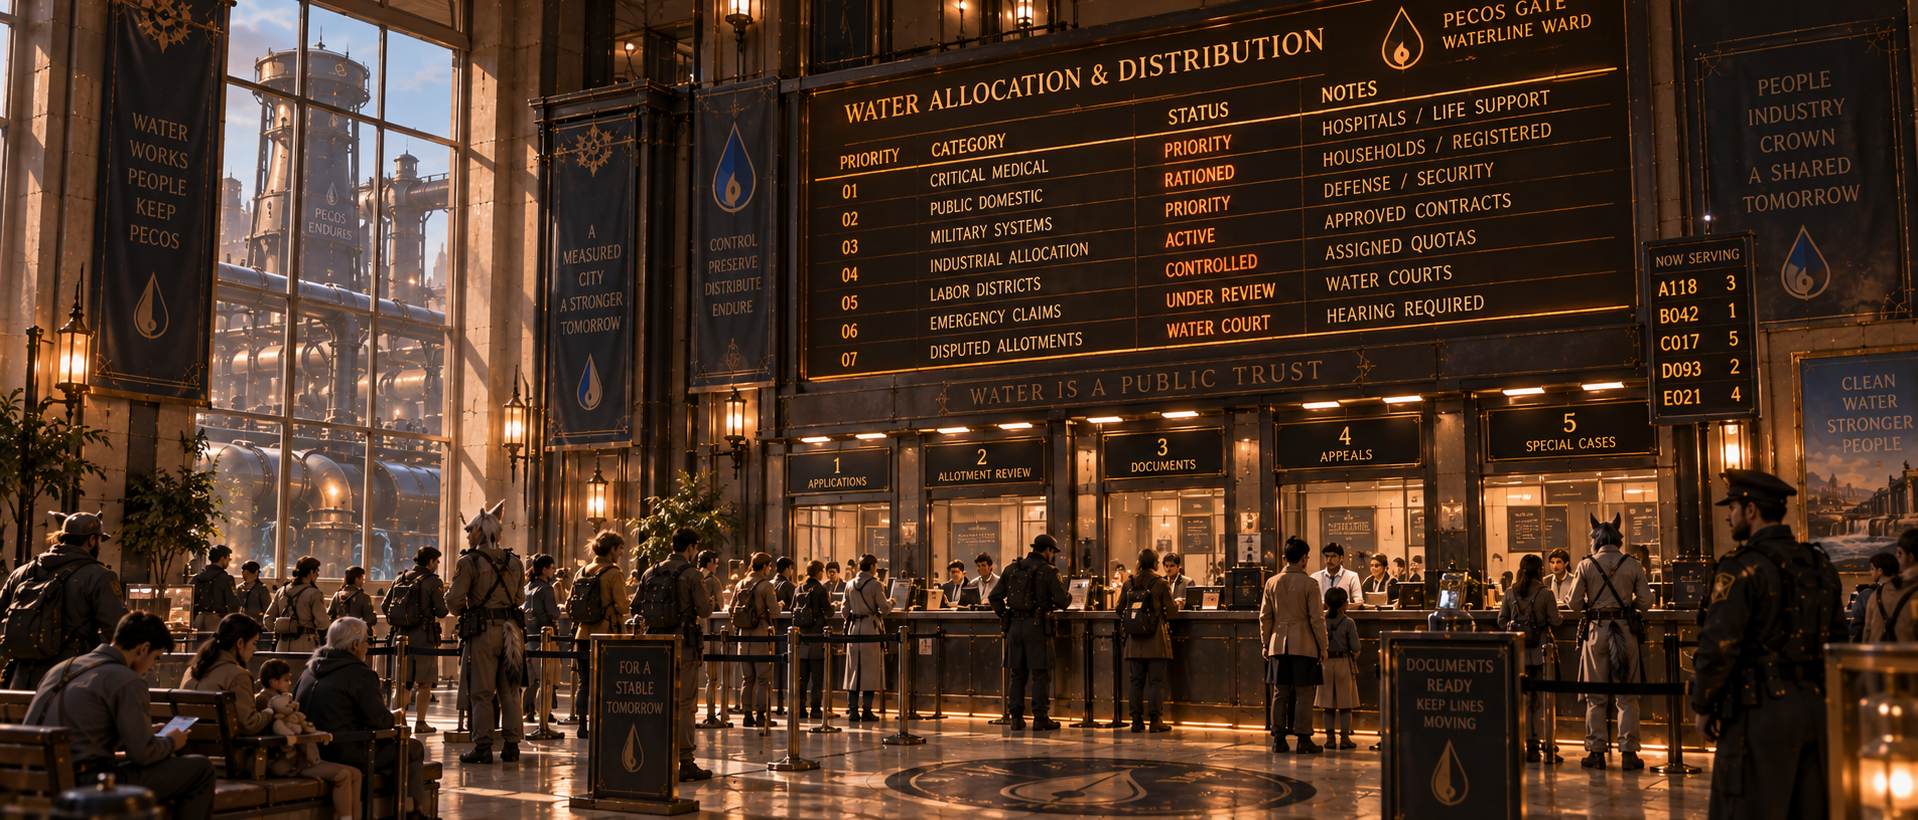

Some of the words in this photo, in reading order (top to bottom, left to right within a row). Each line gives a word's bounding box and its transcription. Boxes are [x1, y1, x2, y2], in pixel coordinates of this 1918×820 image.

[1443, 4, 1506, 28] PECOS
[1441, 23, 1534, 49] WATERLINE
[1541, 14, 1592, 33] WARD
[844, 94, 920, 123] WATER
[928, 67, 1082, 111] ALLOCATION
[1090, 64, 1109, 85] &
[1118, 28, 1324, 81] DISTRIBUTION
[1758, 70, 1832, 96] PEOPLE
[1748, 98, 1845, 125] INDUSTRY
[132, 113, 188, 142] WATER
[840, 148, 900, 169] PRIORITY
[931, 133, 1006, 157] CATEGORY
[1168, 102, 1229, 125] STATUS
[1321, 80, 1378, 103] NOTES
[842, 184, 858, 200] 01
[930, 168, 986, 187] CRITICAL
[992, 160, 1049, 179] MEDICAL
[1164, 134, 1234, 158] PRIORITY
[1322, 110, 1407, 136] HOSPITALS
[1415, 108, 1423, 124] /
[1433, 102, 1466, 120] LIFE
[1475, 90, 1551, 116] SUPPORT
[1760, 128, 1835, 153] CROWN
[129, 140, 188, 169] WORKS
[842, 212, 859, 227] 02
[930, 198, 973, 215] PUBLIC
[979, 189, 1043, 209] DOMESTIC
[1164, 165, 1235, 187] RATIONED
[1322, 139, 1427, 168] HOUSEHOLDS
[1435, 136, 1443, 153] /
[1452, 123, 1552, 149] REGISTERED
[1748, 167, 1762, 184] A
[1771, 157, 1851, 181] SHARED
[128, 168, 187, 196] PEOPLE
[842, 239, 859, 255] 03
[930, 225, 988, 244] MILITARY
[994, 217, 1053, 236] SYSTEMS
[1165, 196, 1231, 217] PRIORITY
[1324, 176, 1391, 198] DEFENSE
[1400, 173, 1408, 189] /
[1417, 162, 1494, 186] SECURITY
[1742, 185, 1861, 213] TOMORROW
[136, 198, 176, 220] KEEP
[314, 208, 347, 224] PECOS
[129, 224, 180, 249] PECOS
[308, 222, 353, 240] ENDURES
[587, 225, 596, 239] A
[841, 267, 859, 283] 04
[930, 252, 1003, 272] INDUSTRIAL
[1008, 242, 1089, 264] ALLOCATION
[1165, 228, 1216, 247] ACTIVE
[1324, 206, 1406, 229] APPROVED
[1415, 193, 1512, 218] CONTRACTS
[709, 234, 758, 251] CONTROL
[562, 244, 622, 265] MEASURED
[708, 255, 758, 273] PRESERVE
[1655, 254, 1684, 268] NOW
[1688, 248, 1740, 264] SERVING
[578, 270, 605, 286] CITY
[841, 295, 858, 311] 05
[930, 285, 970, 301] LABOR
[976, 277, 1042, 296] DISTRICTS
[1165, 254, 1258, 277] CONTROLLED
[1325, 238, 1402, 260] ASSIGNED
[1411, 230, 1477, 253] QUOTAS
[705, 277, 762, 295] DISTRIBUTE
[1658, 279, 1698, 296] A118
[1726, 275, 1736, 291] 3
[559, 299, 568, 313] A
[569, 292, 623, 311] STRONGER
[712, 300, 753, 316] ENDURE
[841, 323, 858, 339] 06
[930, 310, 1006, 330] EMERGENCY
[1012, 304, 1062, 322] CLAIMS
[1166, 289, 1214, 307] UNDER
[1221, 283, 1276, 302] REVIEW
[1325, 273, 1380, 291] WATER
[1388, 265, 1453, 285] COURTS
[1659, 306, 1699, 323] B042
[1728, 303, 1736, 319] 1
[560, 316, 622, 335] TOMORROW
[841, 352, 858, 368] 07
[930, 341, 991, 359] DISPUTED
[996, 332, 1083, 353] ALLOTMENTS
[1166, 320, 1215, 338] WATER
[1221, 315, 1271, 333] COURT
[1327, 303, 1395, 323] HEARING
[1404, 295, 1485, 316] REQUIRED
[1660, 334, 1700, 351] C017
[1729, 331, 1739, 347] 5
[1661, 361, 1702, 378] D093
[1730, 359, 1740, 375] 2
[969, 384, 1044, 404] WATER
[1057, 380, 1078, 398] IS
[1091, 378, 1107, 396] A
[1121, 367, 1221, 395] PUBLIC
[1231, 359, 1323, 385] TRUST
[1841, 374, 1896, 390] CLEAN
[1663, 389, 1701, 405] E021
[1730, 387, 1742, 402] 4
[1842, 395, 1898, 411] WATER
[1563, 413, 1577, 432] 5
[1827, 415, 1914, 433] STRONGER
[1338, 427, 1352, 445] 4
[1525, 439, 1574, 452] SPECIAL
[1578, 436, 1616, 450] CASES
[1842, 436, 1904, 454] PEOPLE
[1157, 438, 1168, 456] 3
[1319, 449, 1373, 463] APPEALS
[833, 458, 841, 474] 1
[976, 449, 987, 465] 2
[1131, 459, 1197, 473] DOCUMENTS
[807, 477, 867, 489] APPLICATIONS
[937, 470, 992, 482] ALLOTMENT
[995, 468, 1032, 479] REVIEW
[619, 661, 640, 675] FOR
[642, 661, 651, 675] A
[1406, 658, 1494, 674] DOCUMENTS
[615, 681, 655, 696] STABLE
[1427, 679, 1473, 693] READY
[605, 701, 664, 715] TOMORROW
[1416, 699, 1446, 711] KEEP
[1449, 700, 1485, 713] LINES
[1423, 716, 1477, 730] MOVING
